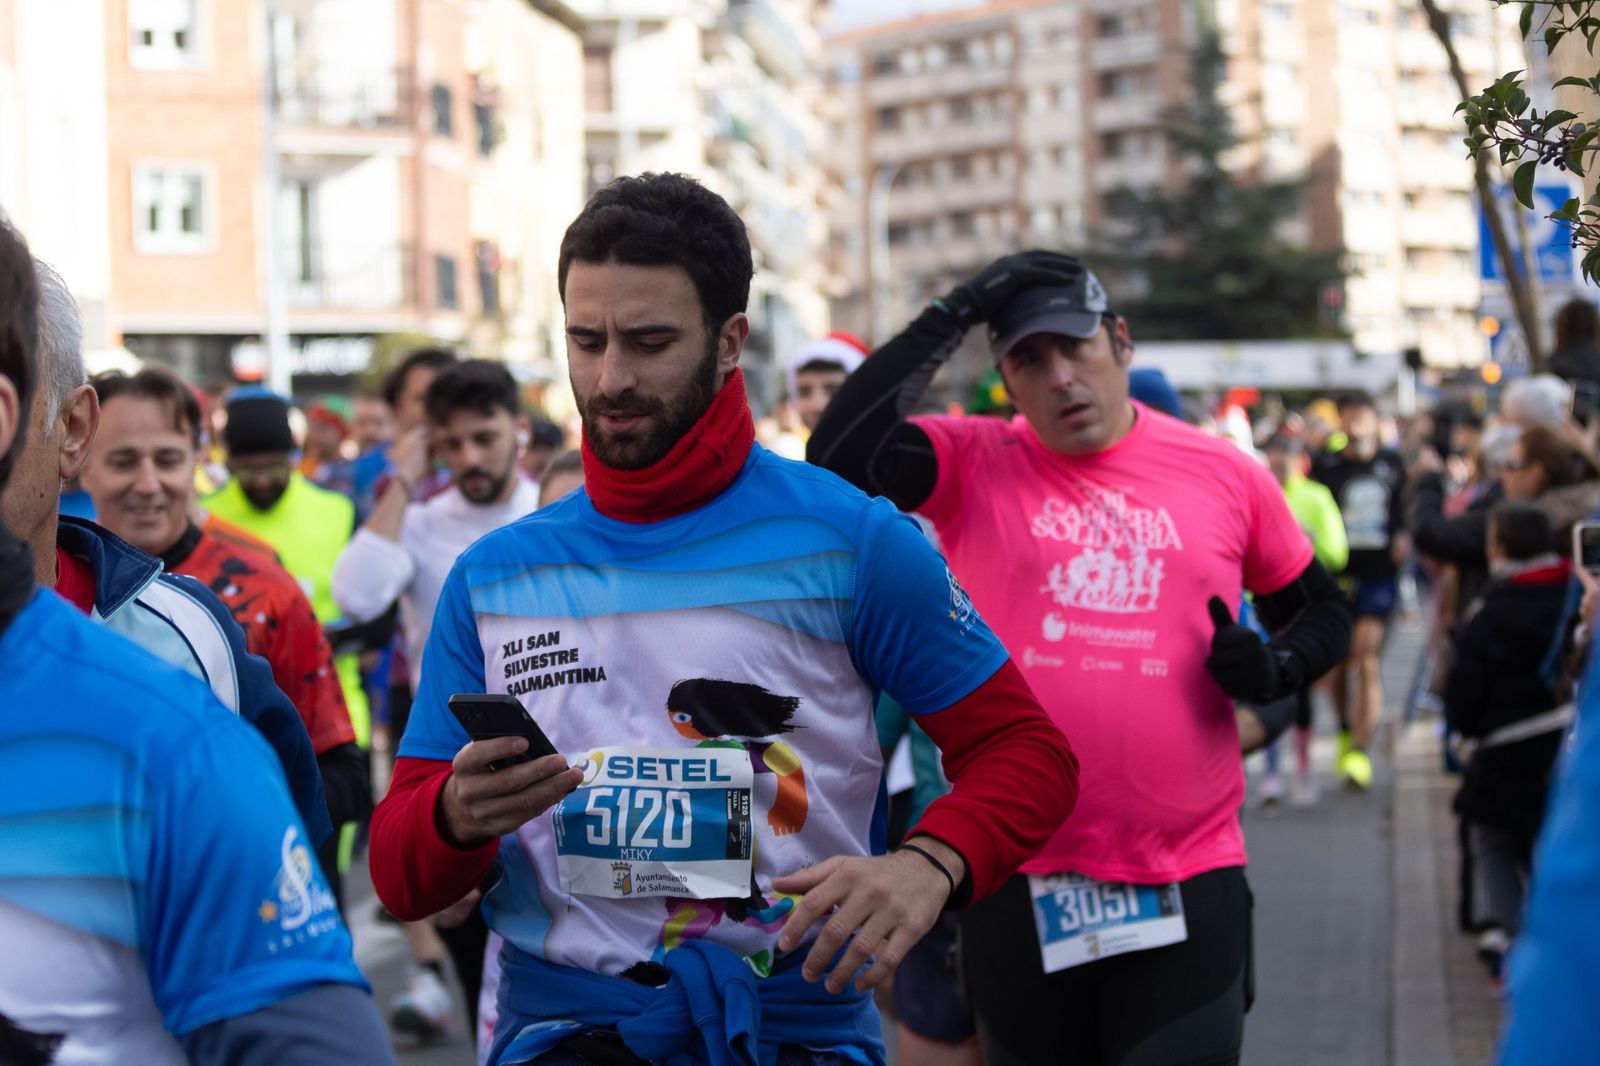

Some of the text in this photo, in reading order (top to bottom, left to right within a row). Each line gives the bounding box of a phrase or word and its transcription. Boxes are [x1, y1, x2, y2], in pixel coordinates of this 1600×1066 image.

[1031, 514, 1183, 551] SOLIDARIA
[502, 631, 560, 659] XLI SAN
[504, 647, 579, 679] SILVESTRE
[506, 666, 606, 698] SALMANTINA
[606, 755, 731, 783] SETEL
[585, 788, 693, 850] 5120
[620, 848, 653, 861] MIKY
[635, 873, 688, 885] Ayuntamiento
[637, 882, 690, 894] de Salamanca
[1054, 884, 1140, 933] 3051
